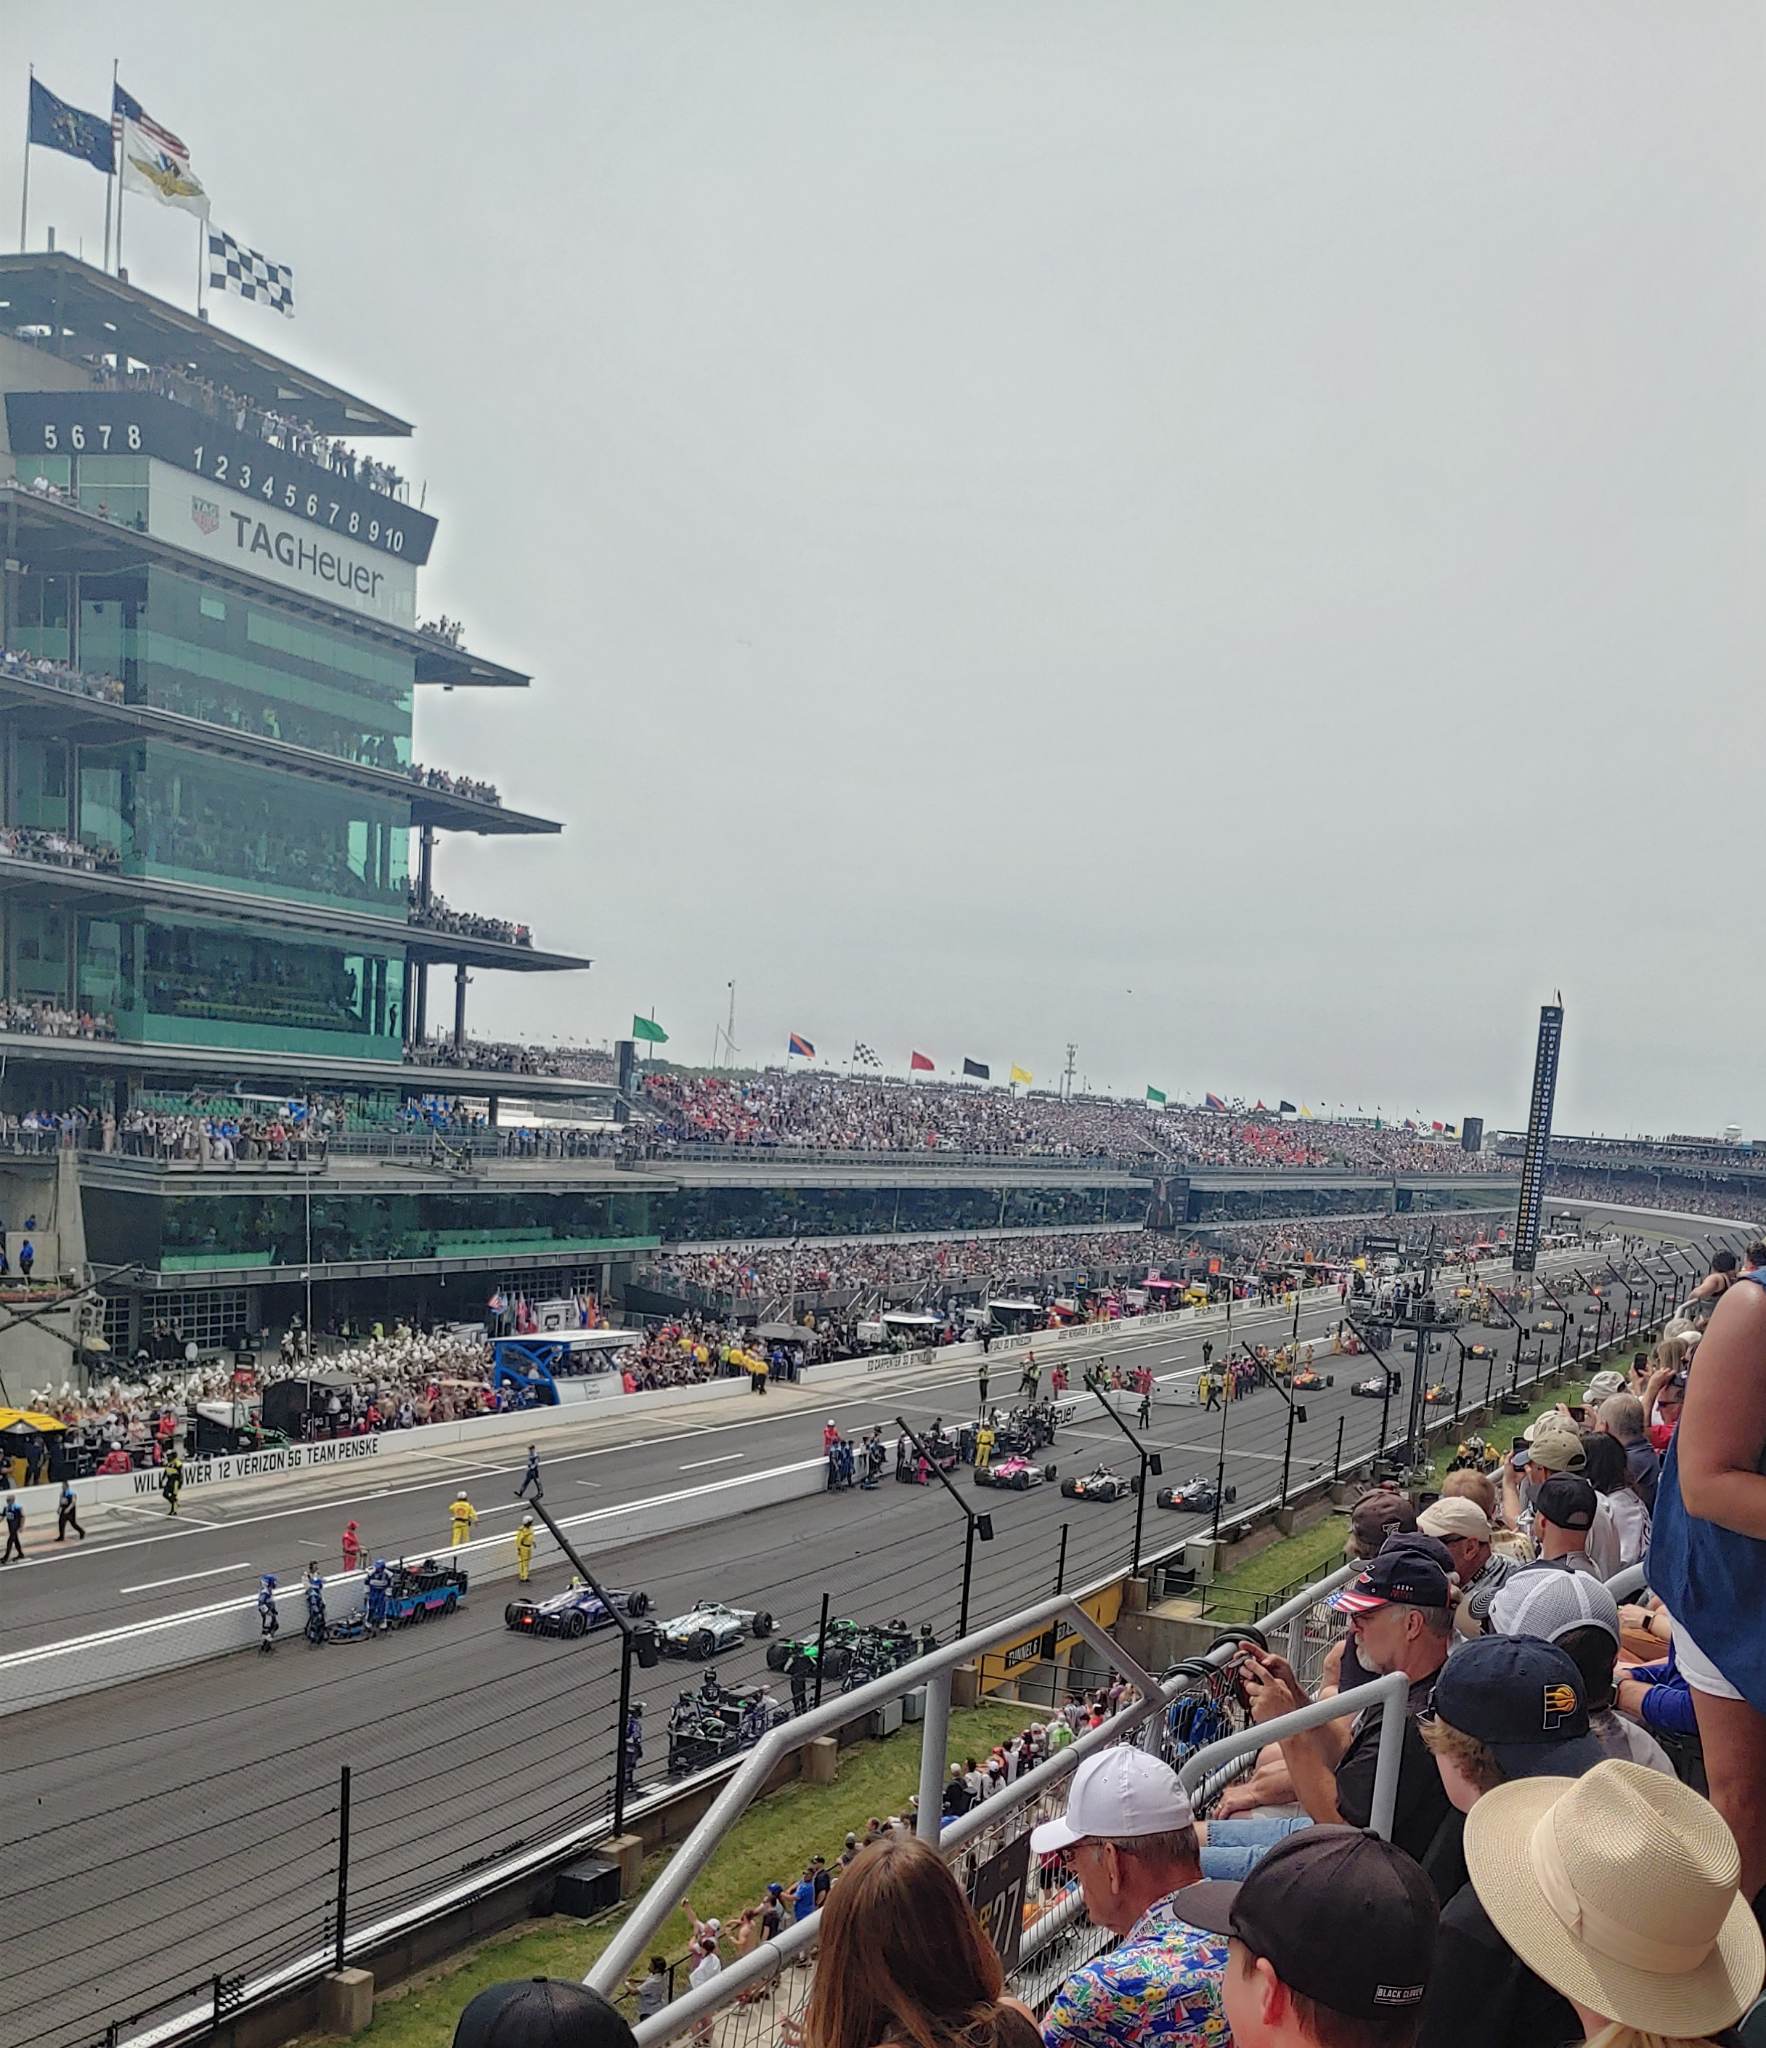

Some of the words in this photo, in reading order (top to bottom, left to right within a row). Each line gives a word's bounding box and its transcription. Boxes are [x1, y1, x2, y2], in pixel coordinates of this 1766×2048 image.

[44, 424, 58, 450] 5
[71, 424, 86, 450] 6
[98, 425, 112, 451] 7
[127, 424, 142, 450] 8
[193, 445, 204, 470] 1
[215, 456, 229, 480] 2
[239, 465, 252, 489] 3
[262, 476, 275, 499] 4
[284, 484, 297, 508] 5
[306, 494, 319, 517] 6
[328, 502, 341, 525] 7
[348, 511, 361, 534] 8
[368, 520, 381, 542] 9
[385, 528, 404, 552] 10
[1506, 1363, 1513, 1374] 3
[184, 1464, 212, 1486] WER
[218, 1461, 231, 1480] 12
[236, 1451, 285, 1476] VERIZON
[288, 1450, 302, 1468] 5G
[307, 1443, 336, 1465] TEAM
[338, 1438, 378, 1460] PENSKE
[1008, 1641, 1032, 1668] TUNNEL
[1377, 1988, 1402, 1998] BLACK
